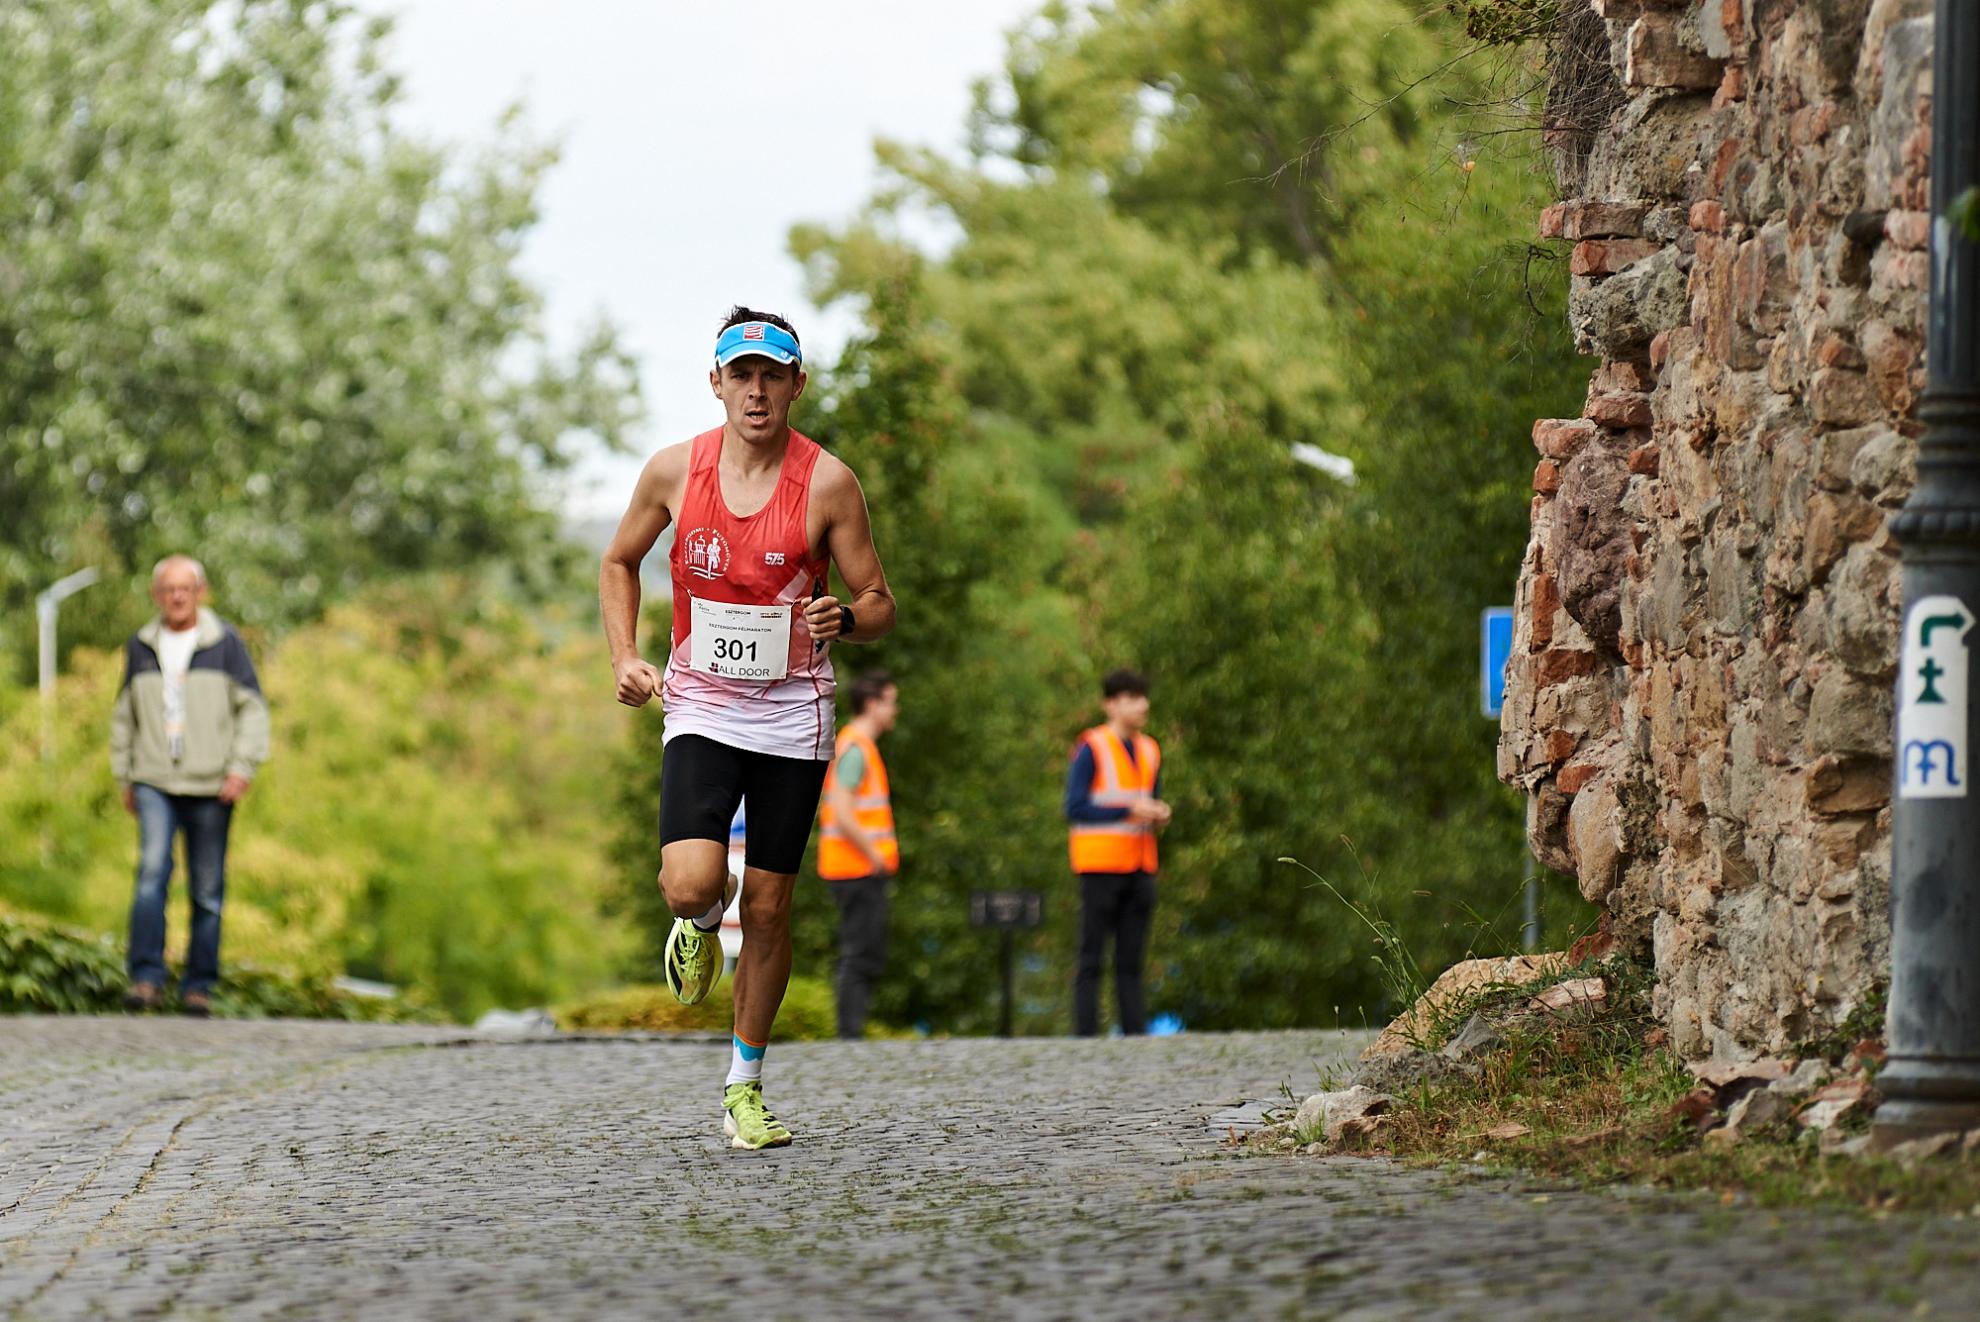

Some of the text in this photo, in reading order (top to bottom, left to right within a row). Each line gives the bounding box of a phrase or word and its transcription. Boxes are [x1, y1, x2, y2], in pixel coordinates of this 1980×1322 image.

[714, 638, 756, 662] 301
[720, 666, 770, 676] ALL DOOR
